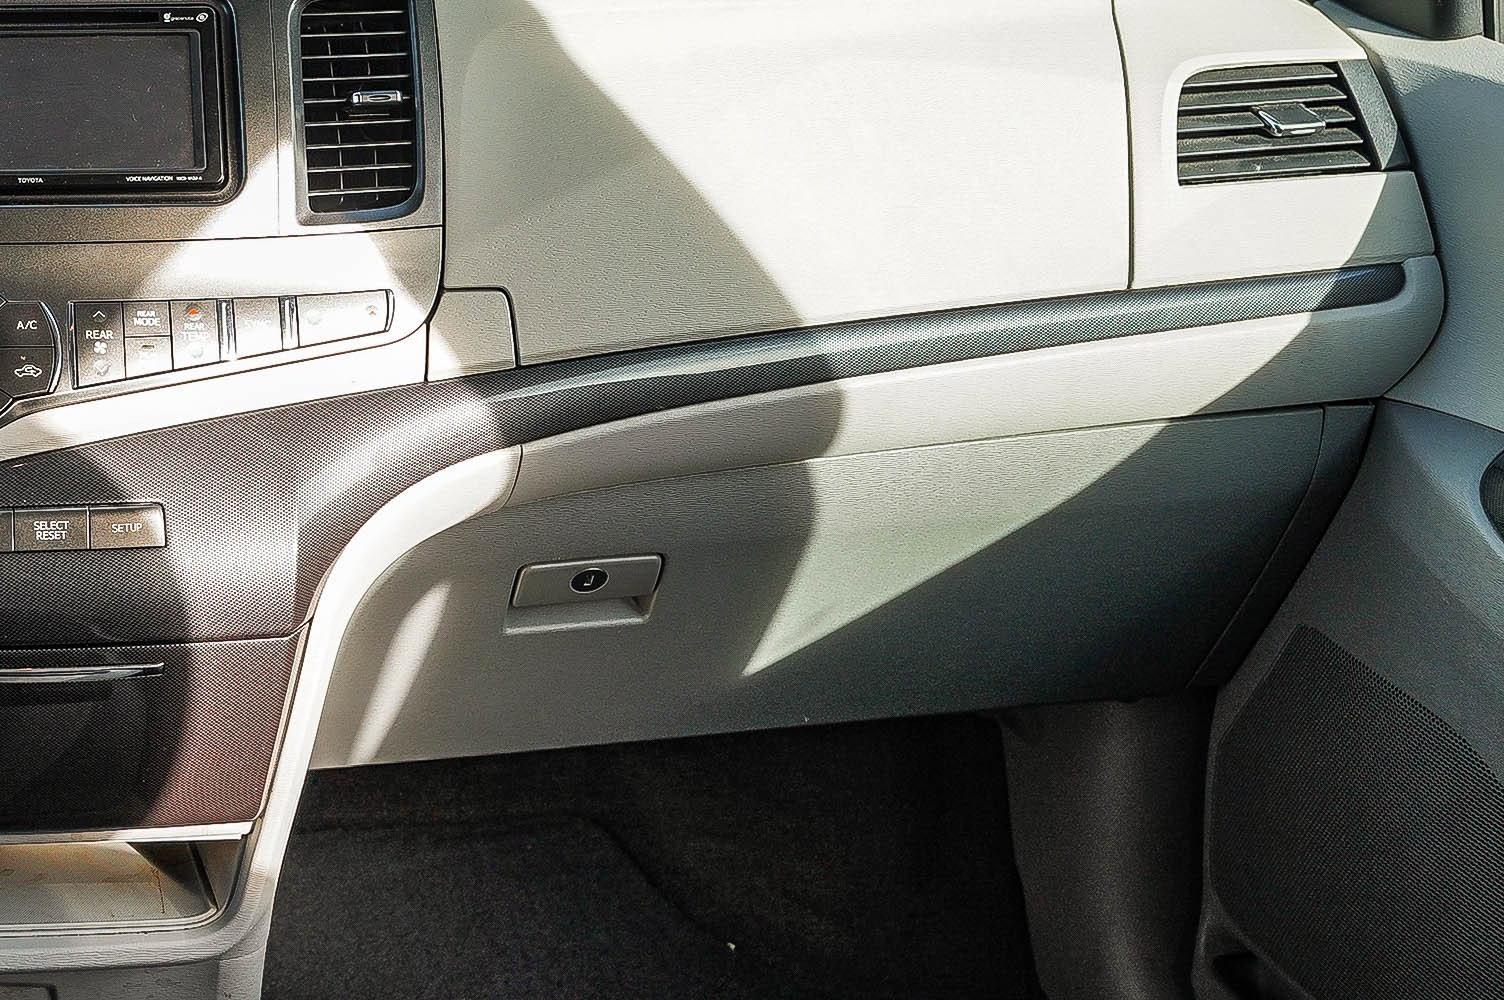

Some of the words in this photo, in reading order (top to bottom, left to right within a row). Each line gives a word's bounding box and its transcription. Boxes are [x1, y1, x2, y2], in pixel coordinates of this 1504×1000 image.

[16, 320, 38, 330] A/C
[133, 318, 161, 327] MODE
[85, 330, 114, 340] REAR
[33, 521, 69, 531] SELECT
[111, 523, 142, 533] SETUP
[36, 531, 67, 541] RESET
